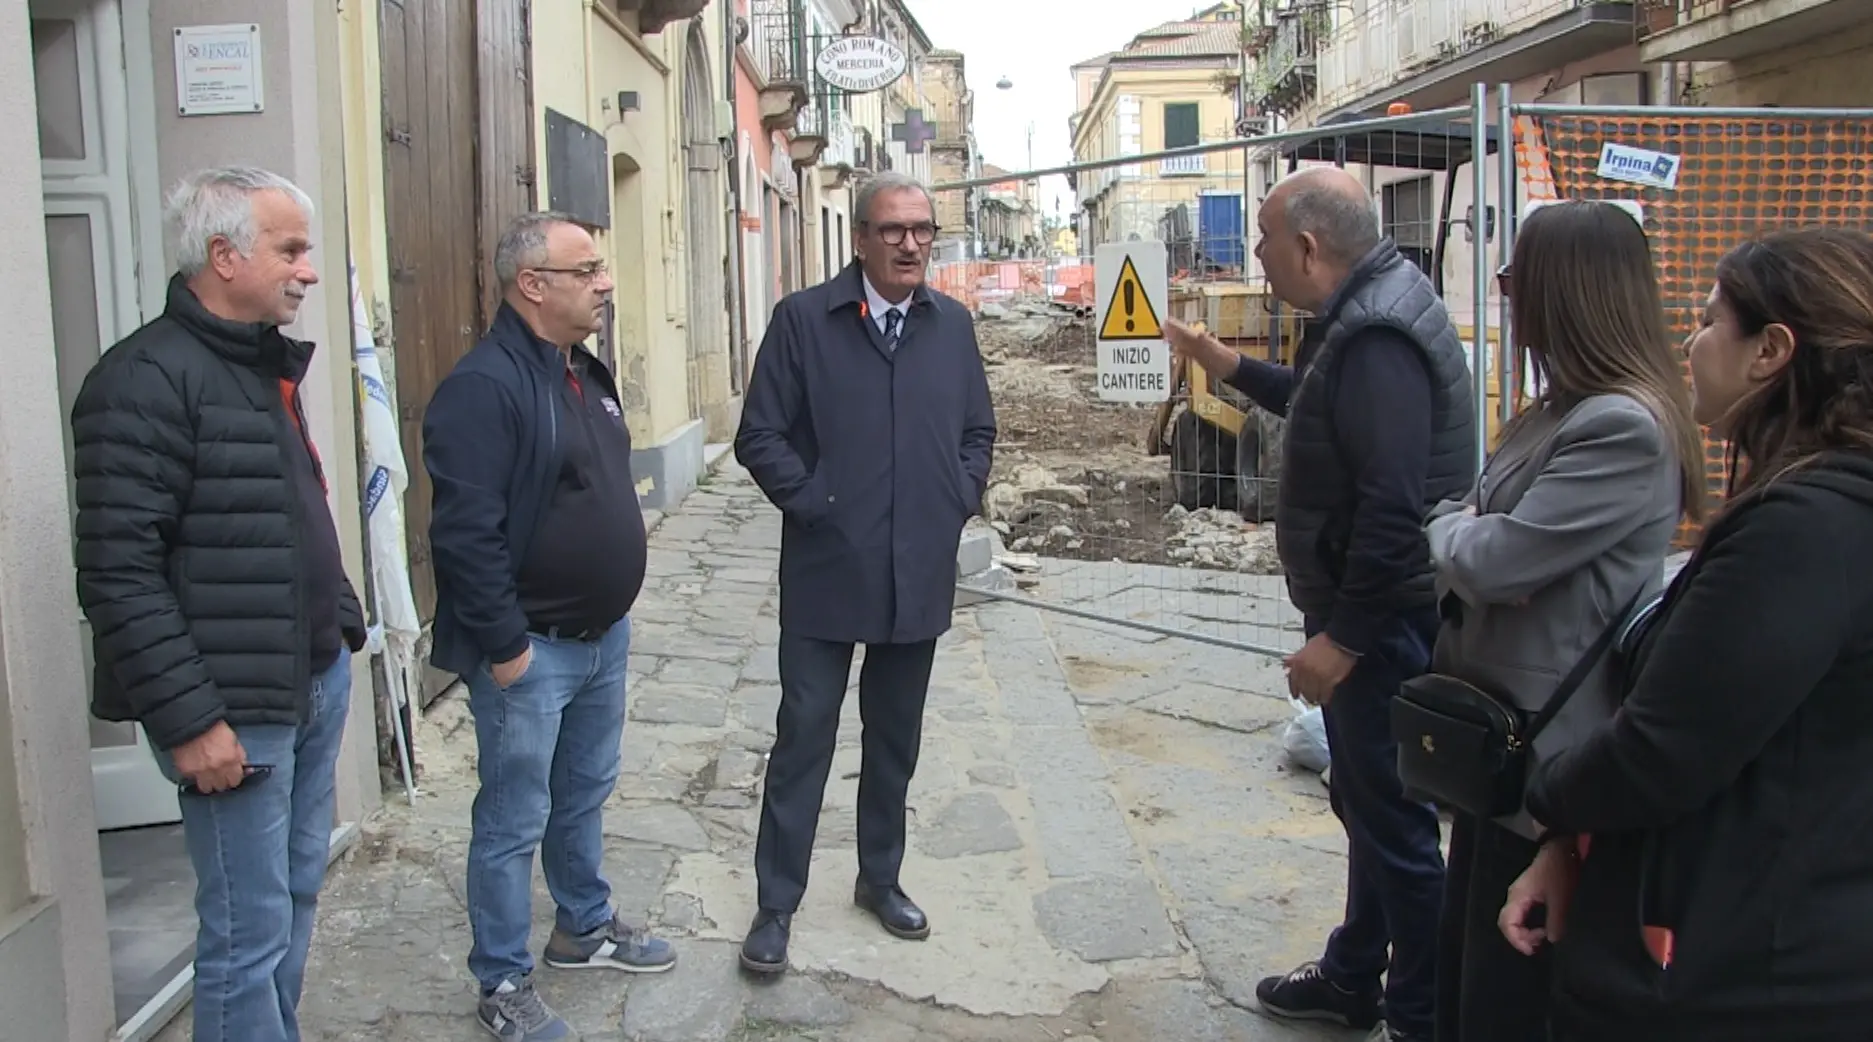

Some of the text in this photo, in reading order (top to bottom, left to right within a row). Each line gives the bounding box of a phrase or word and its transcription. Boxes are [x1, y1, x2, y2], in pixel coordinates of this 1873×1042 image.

[851, 38, 900, 62] ROMANO
[836, 59, 885, 70] MERCERIA
[1604, 148, 1653, 172] Irpina
[1113, 346, 1151, 364] INIZIO
[1102, 373, 1164, 390] CANTIERE
